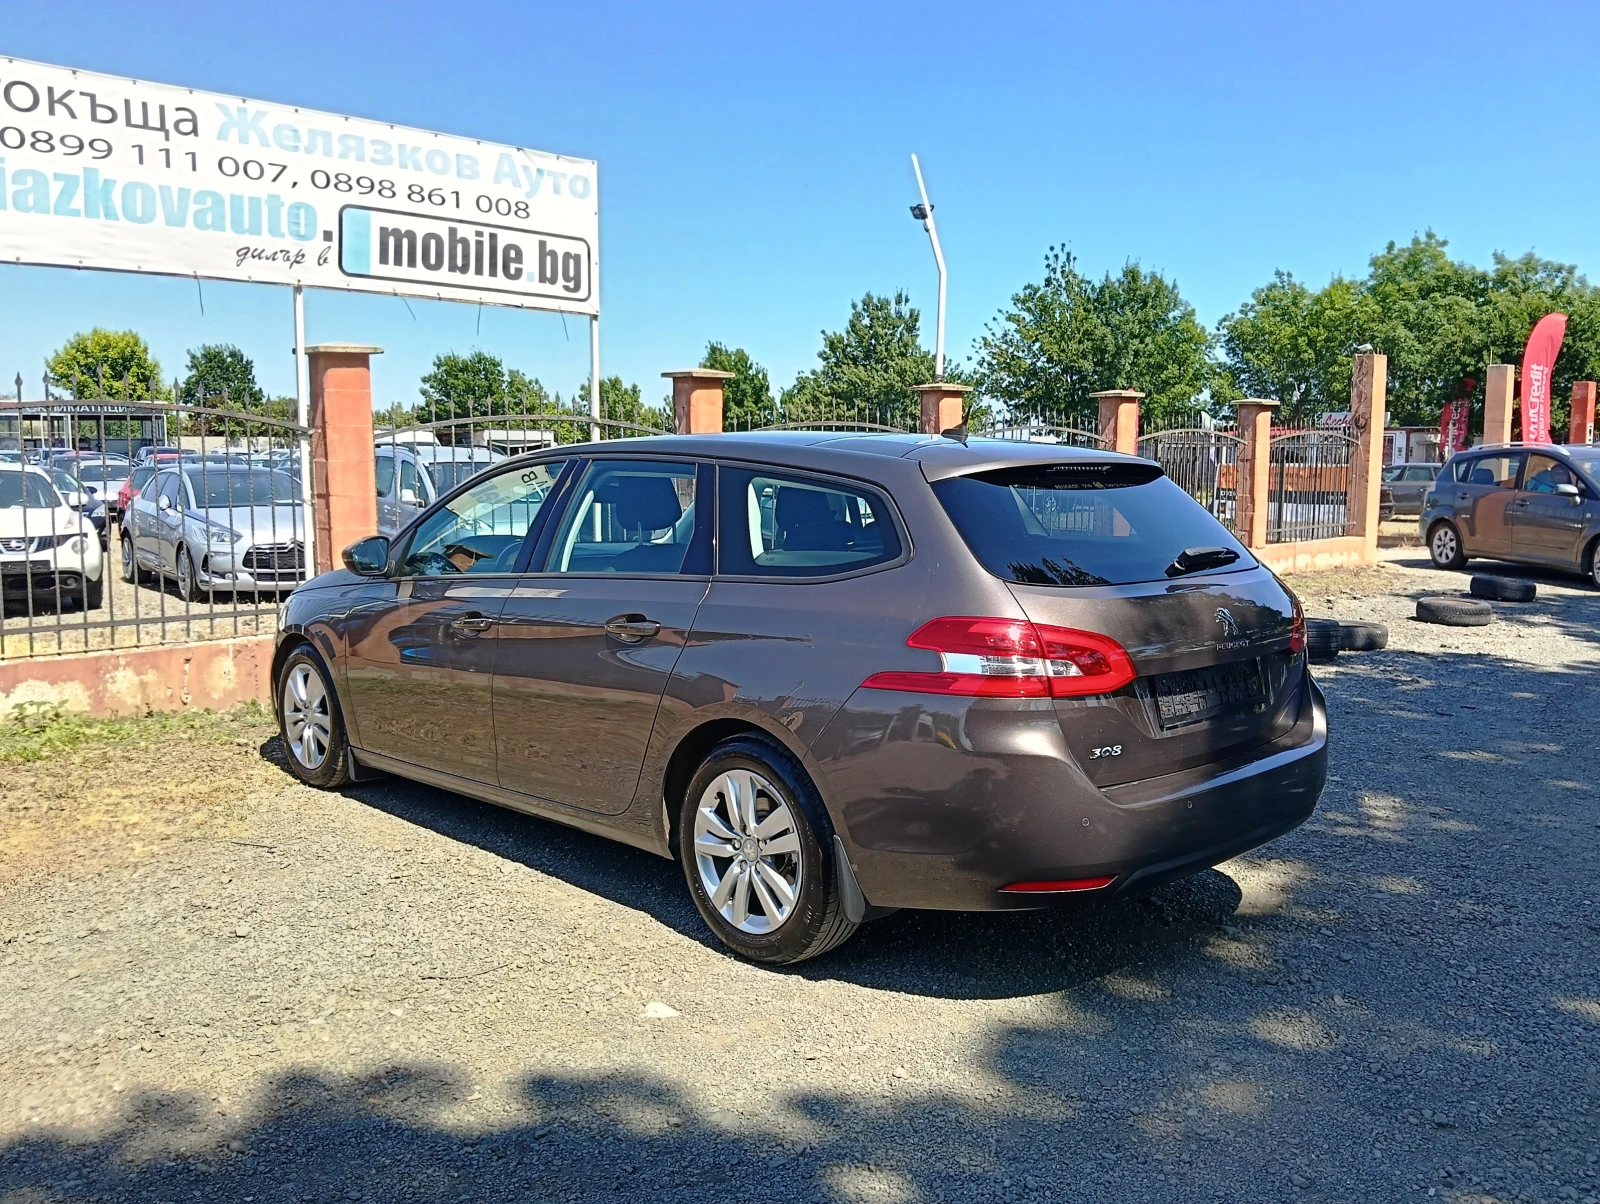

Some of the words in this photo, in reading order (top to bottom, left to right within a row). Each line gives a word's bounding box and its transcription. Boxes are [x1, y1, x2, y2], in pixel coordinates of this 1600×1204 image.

[0, 80, 200, 142] окъща
[213, 102, 480, 181] Желязков
[492, 152, 592, 200] Ауто
[0, 126, 114, 160] 0899
[131, 144, 197, 172] 111
[217, 156, 298, 189] 007,
[310, 169, 397, 199] 0898
[406, 183, 461, 209] 861
[475, 194, 531, 219] 008
[235, 246, 306, 269] дилър
[378, 226, 582, 293] mobile.bg
[1216, 639, 1250, 651] PEUGEOT
[1089, 744, 1123, 759] 308
